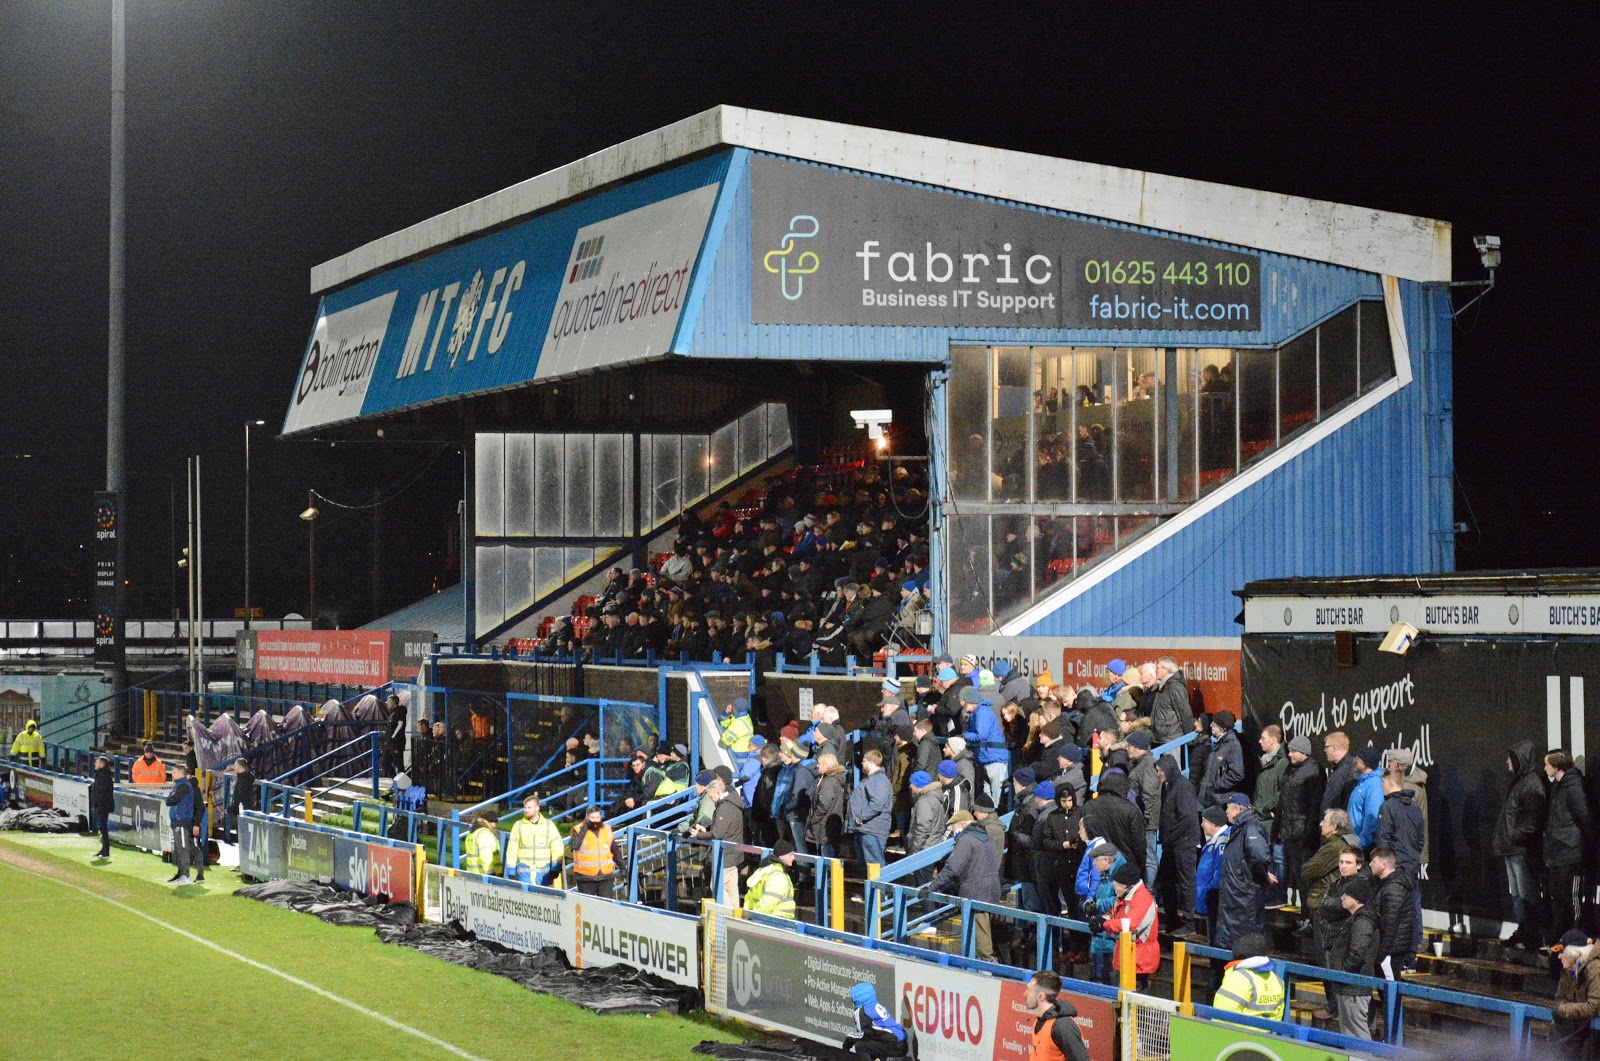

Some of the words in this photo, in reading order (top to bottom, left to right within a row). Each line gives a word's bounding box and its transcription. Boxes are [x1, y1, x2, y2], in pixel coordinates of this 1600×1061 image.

[855, 240, 1052, 285] fabric
[1084, 259, 1156, 285] 01625
[1162, 261, 1209, 286] 443
[1214, 262, 1251, 286] 110
[553, 259, 689, 351] quotelinedirect
[862, 288, 948, 308] Business
[953, 290, 972, 308] IT
[977, 290, 1055, 313] Support
[1089, 294, 1250, 320] fabric-it.com
[96, 529, 116, 540] spiral
[1316, 607, 1346, 626] BUTCH'S
[1348, 607, 1364, 626] BAR
[1425, 606, 1460, 625] BUTCH'S
[1462, 605, 1479, 625] BAR
[1549, 605, 1587, 626] BUTCH'S
[96, 635, 115, 646] spiral
[1077, 659, 1092, 678] Call
[1204, 664, 1229, 682] team
[1280, 692, 1328, 743] Proud
[1332, 697, 1348, 728] to
[1352, 673, 1415, 731] support
[349, 846, 368, 894] sky
[371, 851, 394, 898] bet
[445, 886, 469, 931] Bailey
[470, 889, 562, 926] www.baileystreetscene.co.uk
[497, 923, 524, 949] Canopies
[582, 920, 689, 977] PALLETOWER
[807, 955, 822, 972] Digital
[822, 959, 852, 978] Infrastructure
[852, 966, 877, 985] Specialists
[807, 974, 830, 993] Pro-Active
[819, 997, 831, 1014] Apps
[831, 1000, 836, 1014] &
[902, 982, 983, 1046] SEDULO
[1003, 1038, 1022, 1055] Funding
